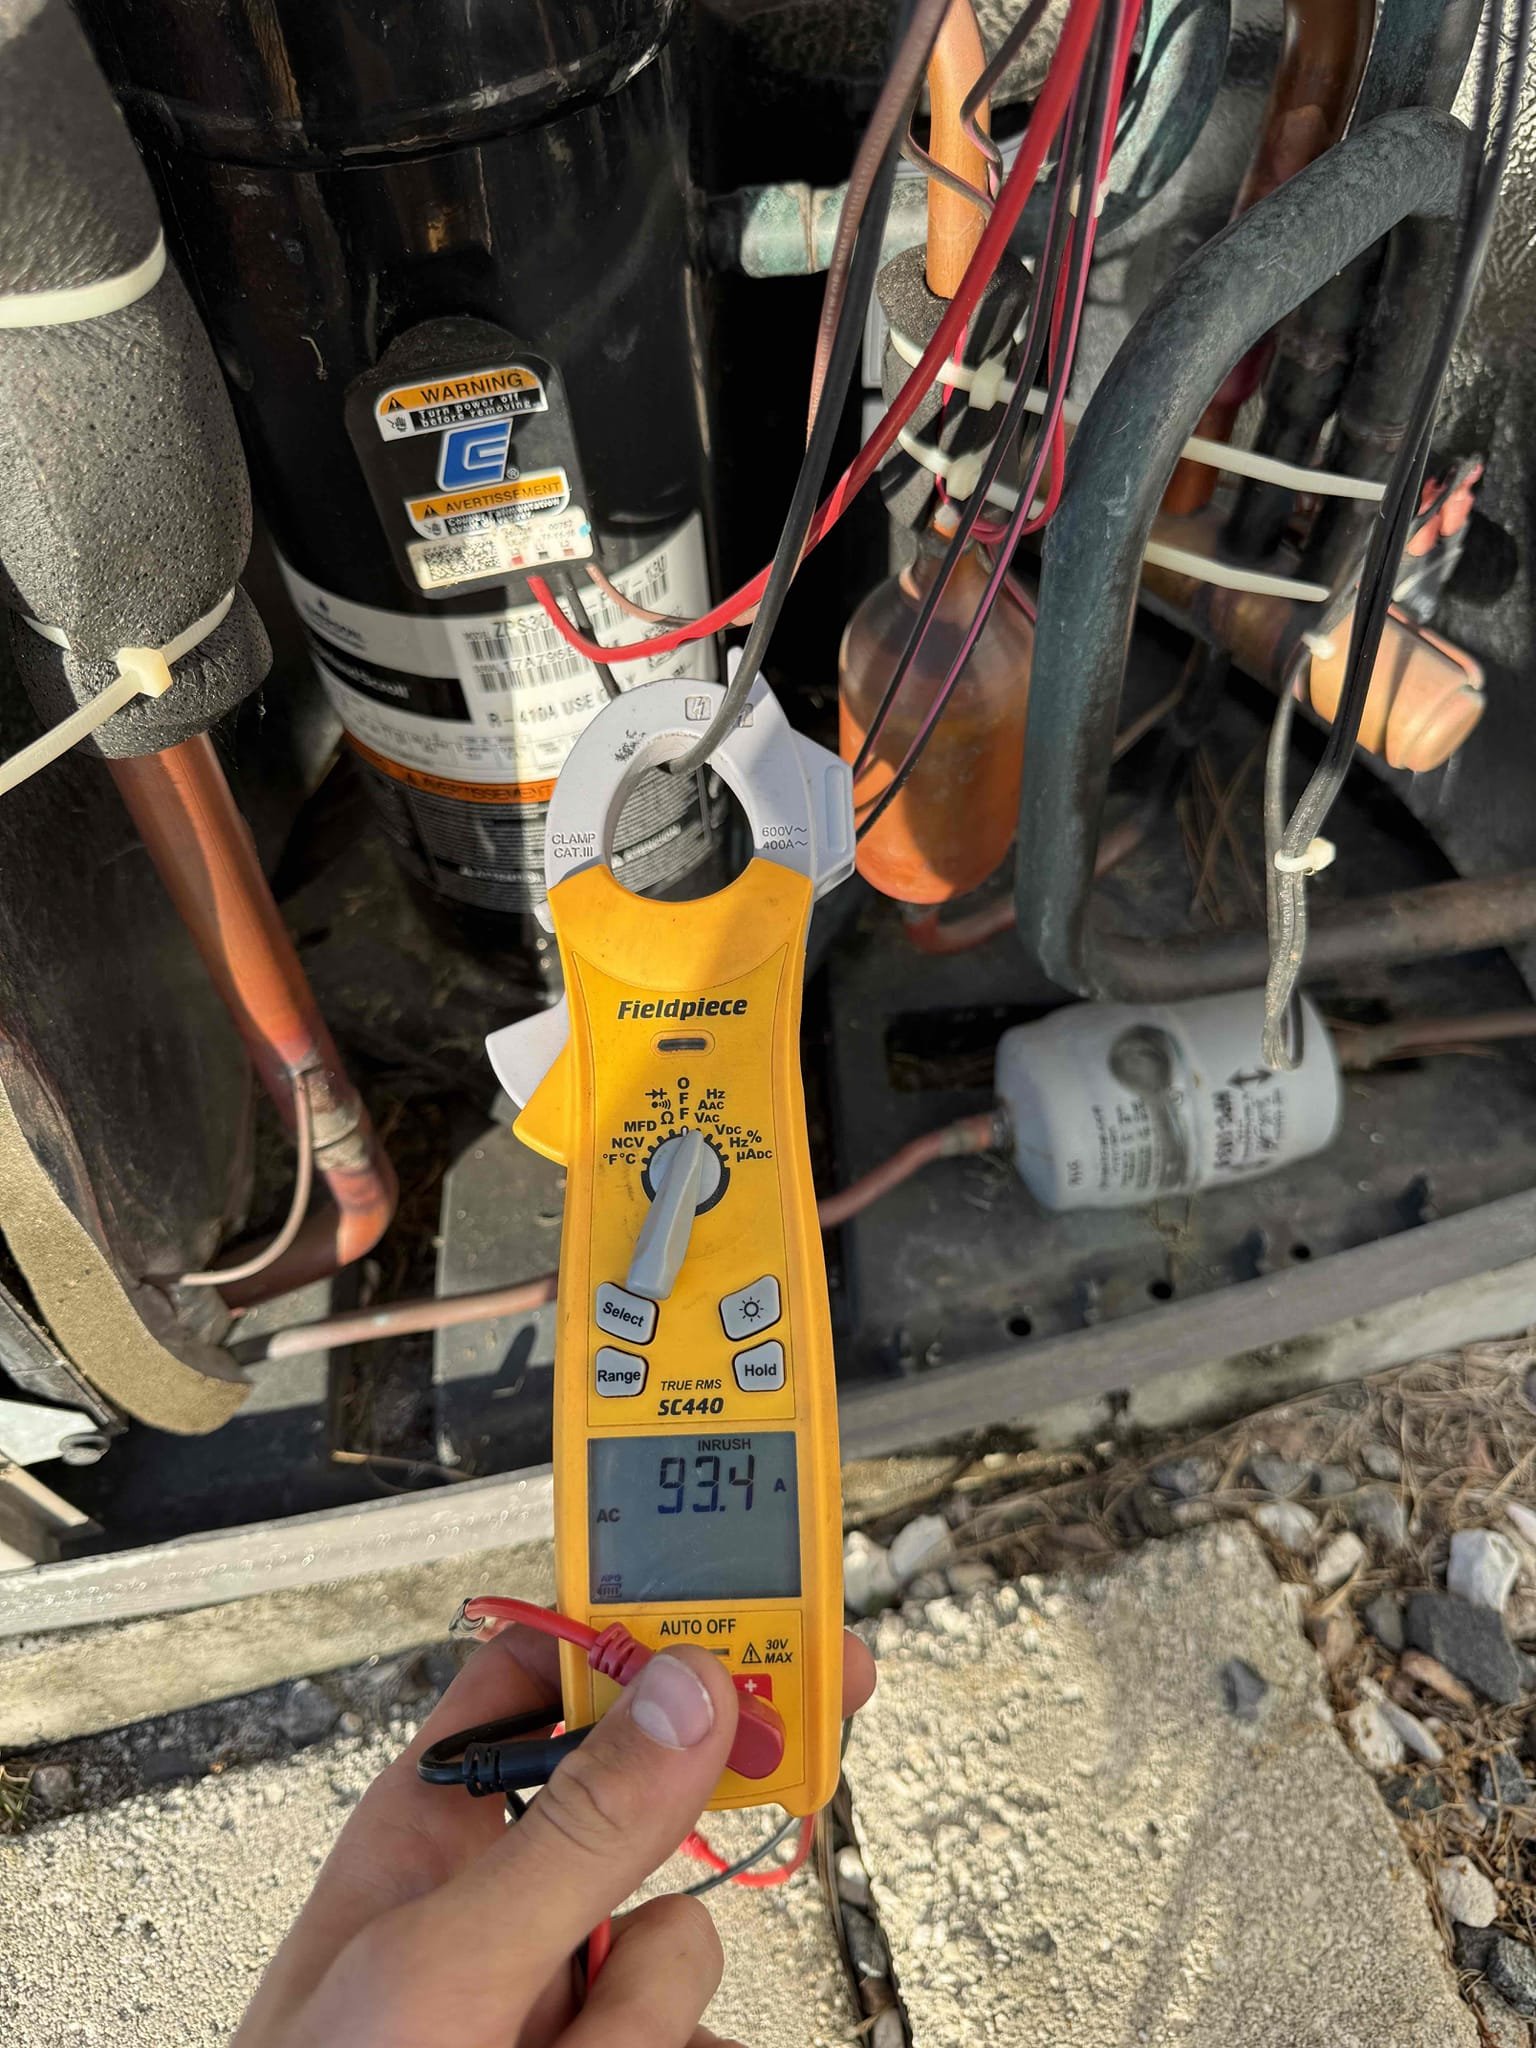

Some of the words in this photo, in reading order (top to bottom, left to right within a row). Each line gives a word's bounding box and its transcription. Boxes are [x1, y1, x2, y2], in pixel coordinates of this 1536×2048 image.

[420, 372, 523, 404] WARNING
[418, 407, 450, 420] Turn
[455, 398, 495, 415] power
[501, 392, 519, 403] off
[420, 414, 465, 428] before
[446, 482, 561, 513] AVERTISSEMENT
[561, 694, 595, 715] USE
[552, 833, 595, 845] CLAMP
[553, 846, 594, 859] CAT.III
[616, 997, 749, 1021] Fieldpiece
[706, 1088, 726, 1099] Hz
[624, 1120, 657, 1133] MFD
[612, 1136, 645, 1149] NCV
[729, 1137, 749, 1148] Hz
[747, 1130, 762, 1143] %
[602, 1301, 645, 1328] Select
[597, 1369, 641, 1384] Range
[744, 1363, 777, 1377] Hold
[660, 1380, 693, 1392] TRUE
[695, 1379, 722, 1390] RMS
[658, 1397, 724, 1417] SC440
[697, 1438, 752, 1452] INRUSH
[657, 1454, 756, 1514] 93.4
[773, 1478, 787, 1492] A
[596, 1508, 621, 1523] AC
[660, 1620, 702, 1636] AUTO
[706, 1619, 736, 1634] OFF
[765, 1638, 789, 1650] 30V
[764, 1652, 793, 1664] MAX
